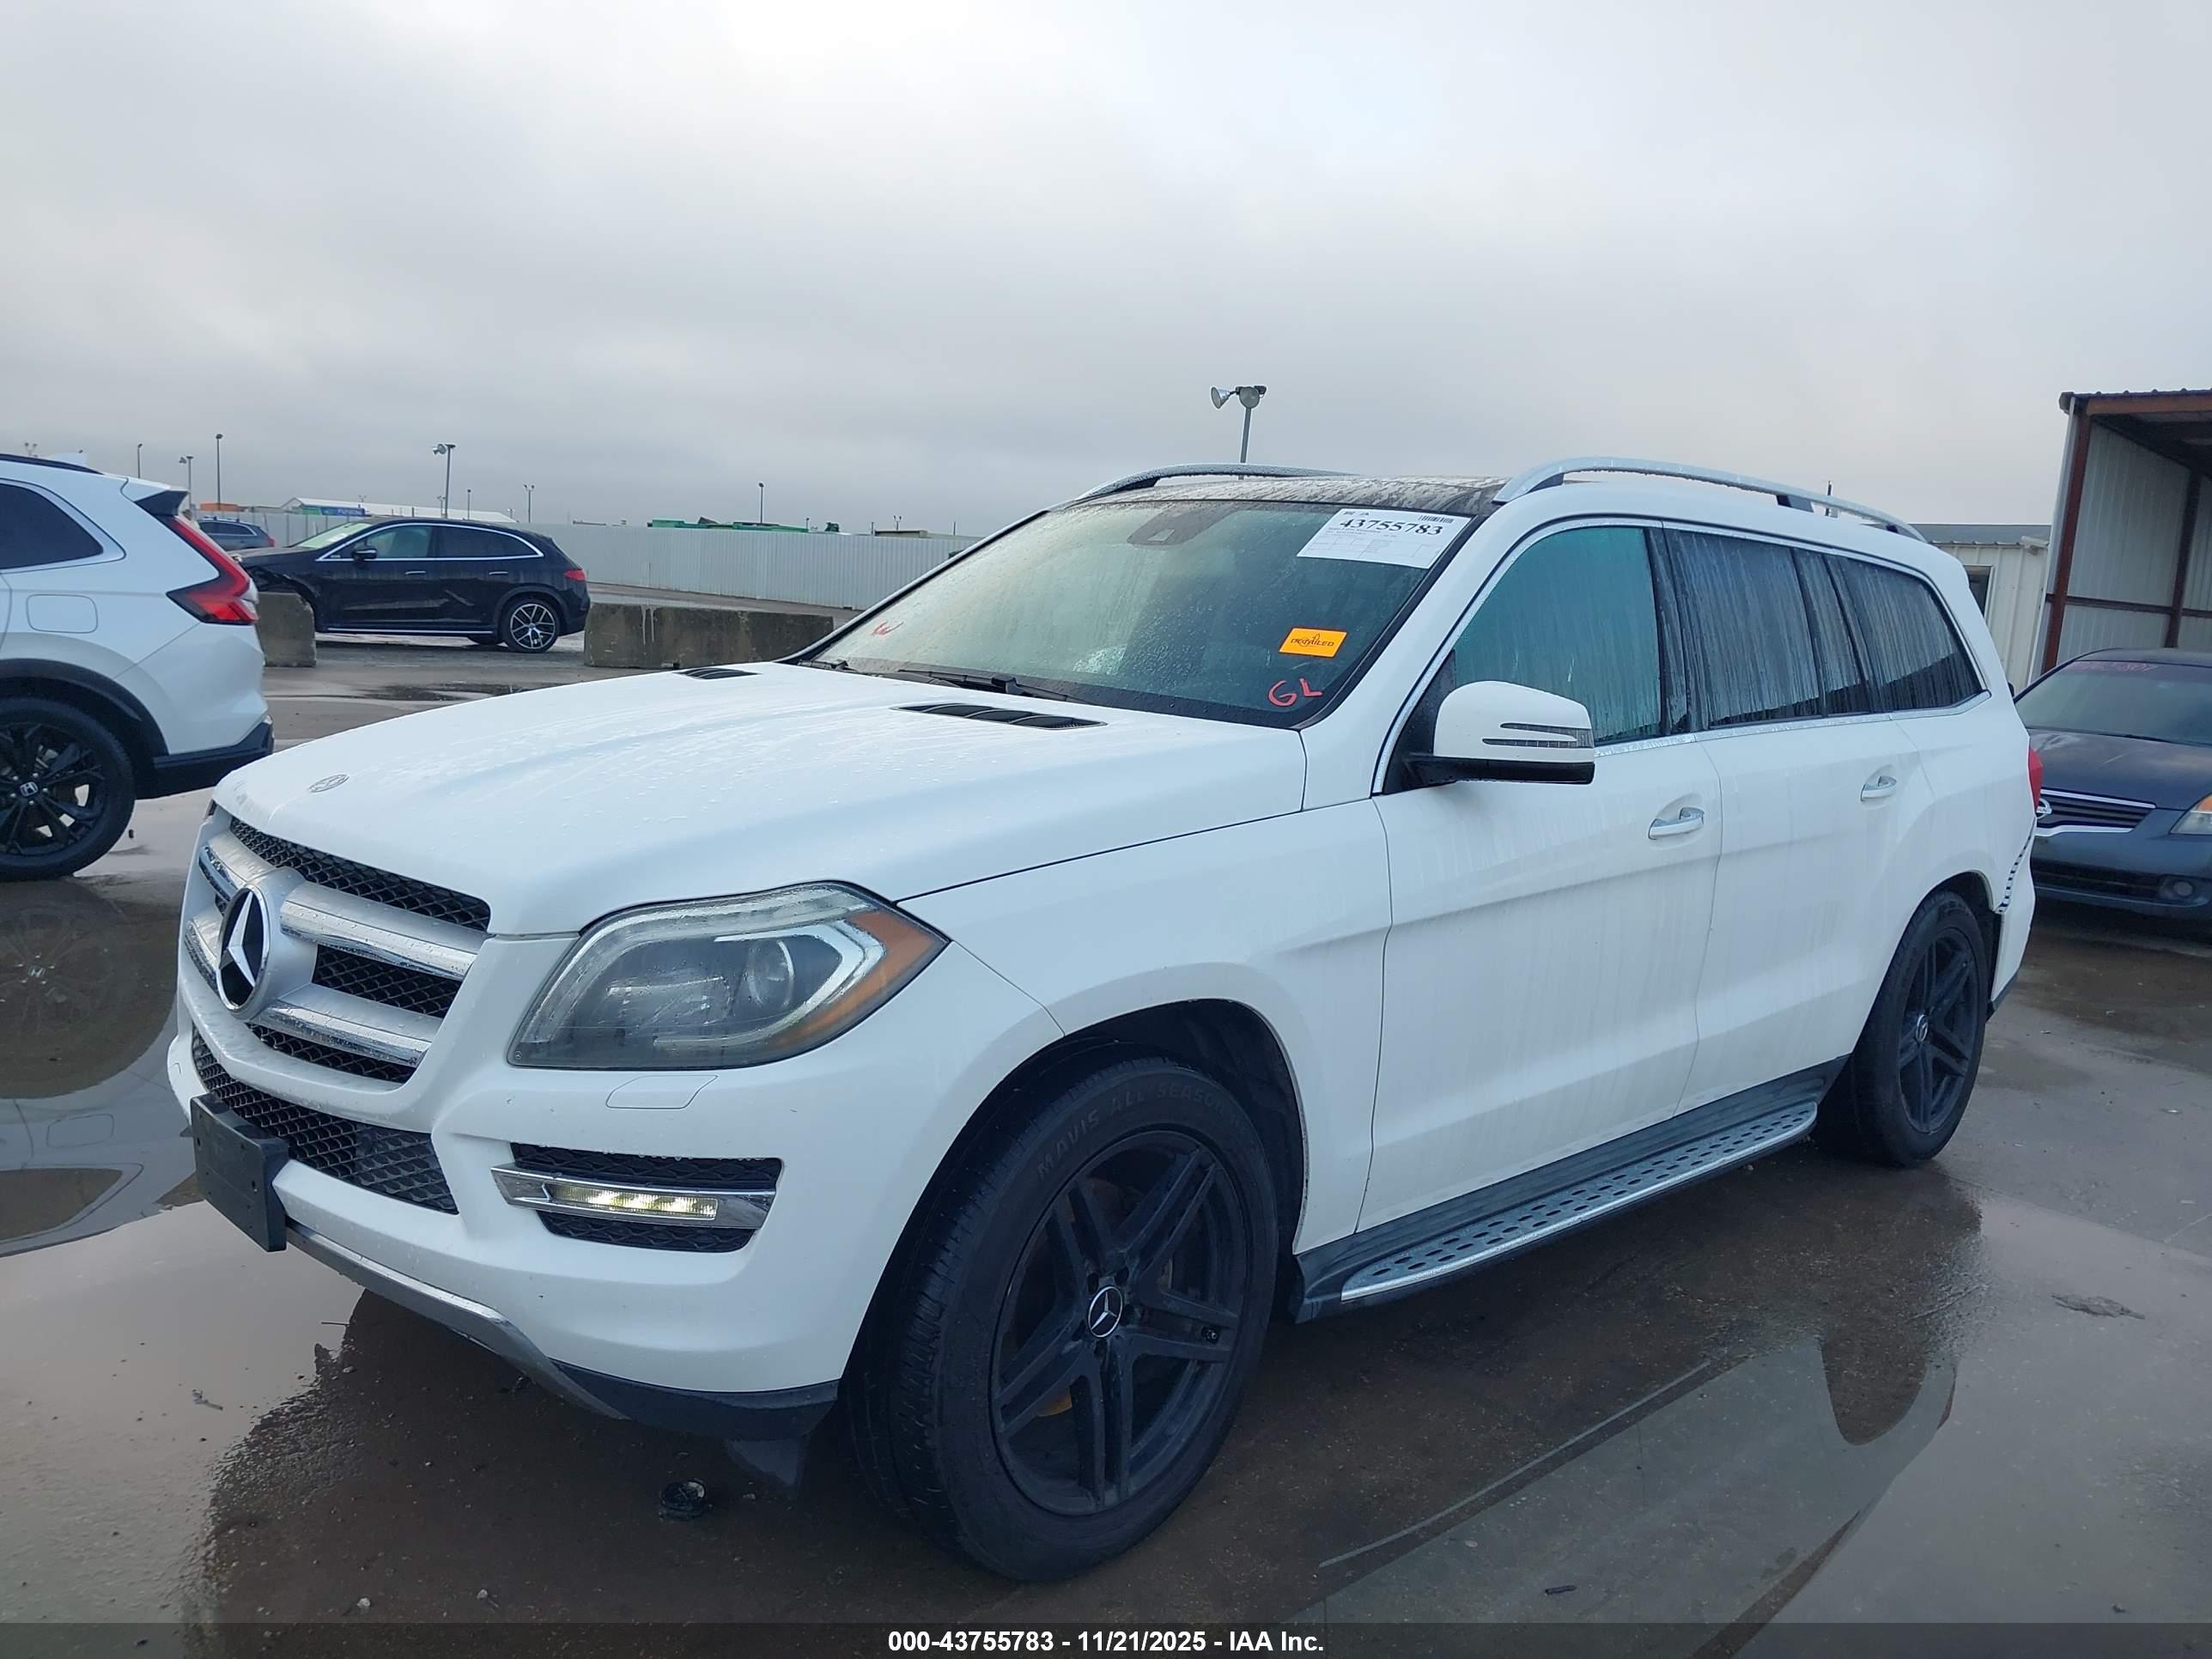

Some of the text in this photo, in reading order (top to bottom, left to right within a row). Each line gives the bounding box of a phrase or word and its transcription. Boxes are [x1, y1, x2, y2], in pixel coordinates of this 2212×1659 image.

[1340, 518, 1443, 536] 43755783
[1036, 1081, 1226, 1182] MAVIS ALL SEASON
